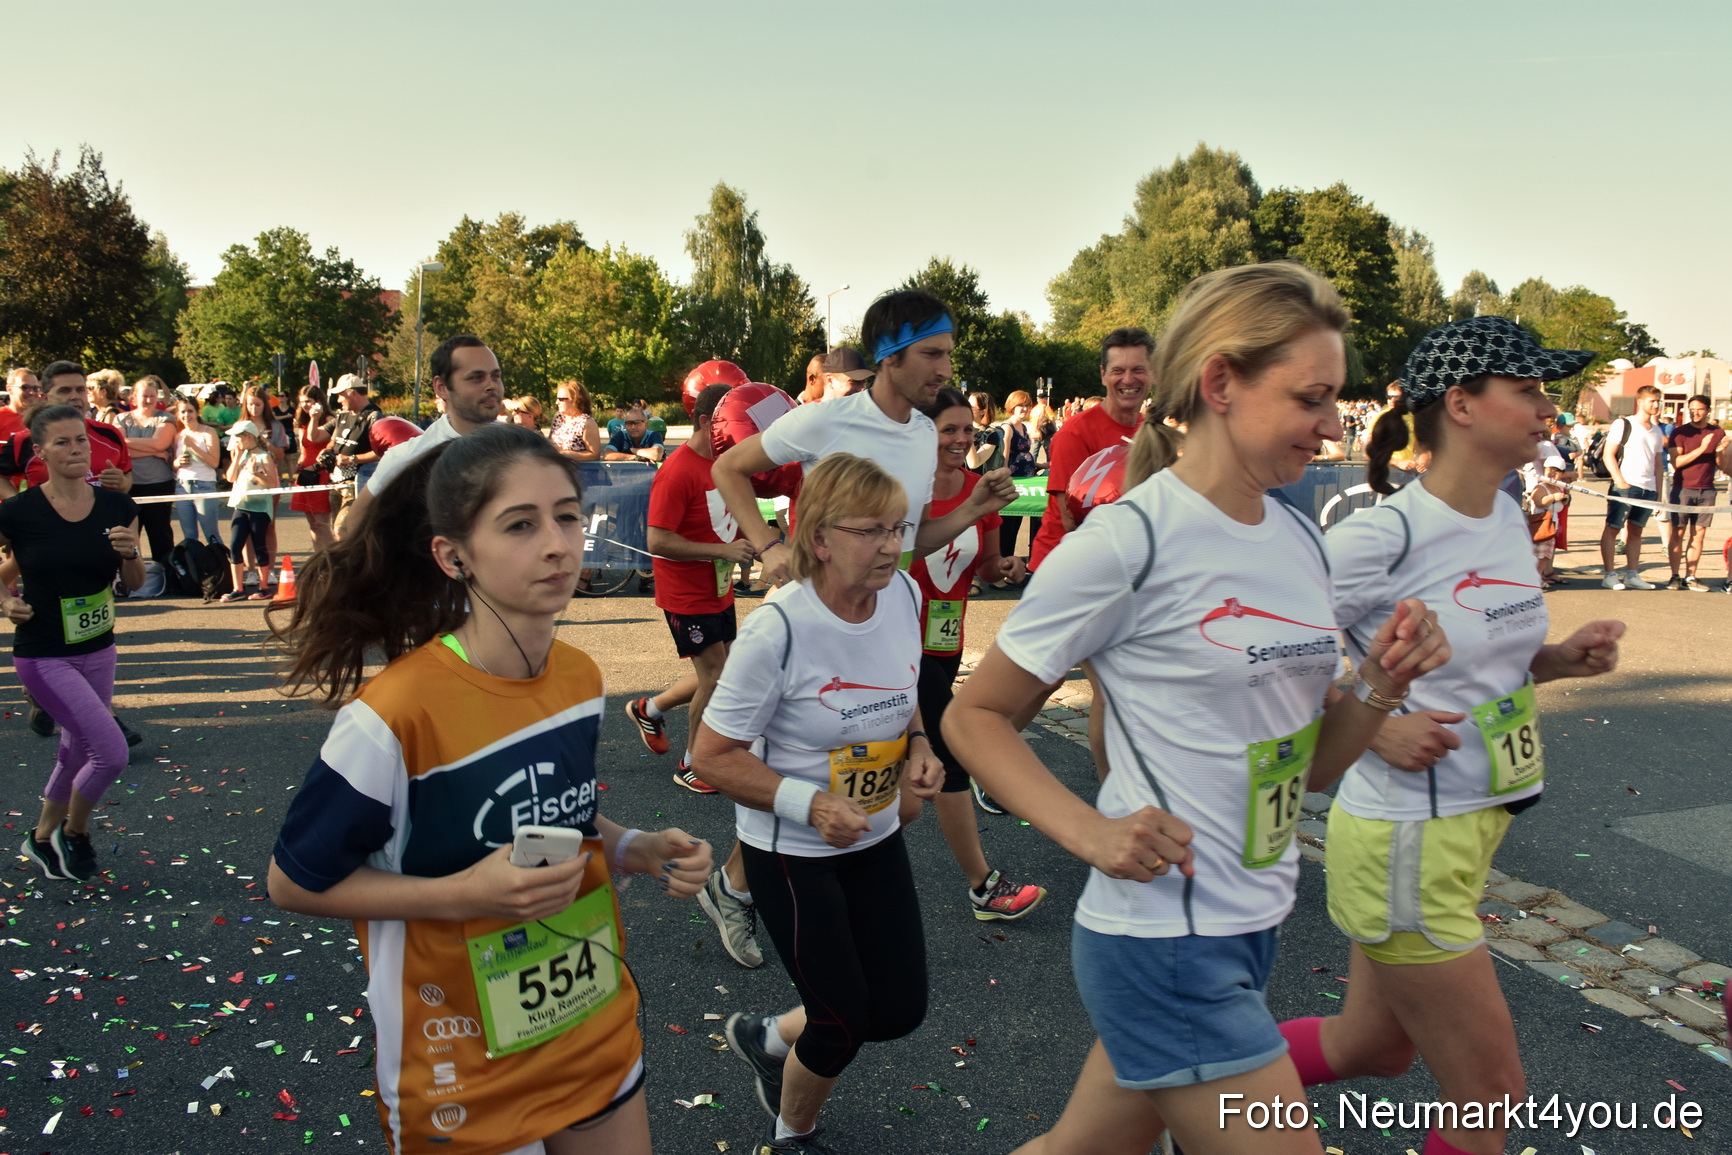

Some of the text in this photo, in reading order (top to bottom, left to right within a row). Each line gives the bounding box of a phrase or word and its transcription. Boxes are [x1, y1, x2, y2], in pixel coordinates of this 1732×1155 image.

[79, 604, 109, 629] 856
[1247, 635, 1335, 664] Seniorenstift
[841, 693, 909, 720] Seniorenstift
[841, 722, 860, 735] am
[861, 711, 894, 731] Tiroler
[519, 939, 597, 1011] 554
[557, 984, 599, 1010] Ramona
[527, 1008, 556, 1026] Klug
[427, 1043, 453, 1055] Audi
[427, 1083, 466, 1097] SEAT
